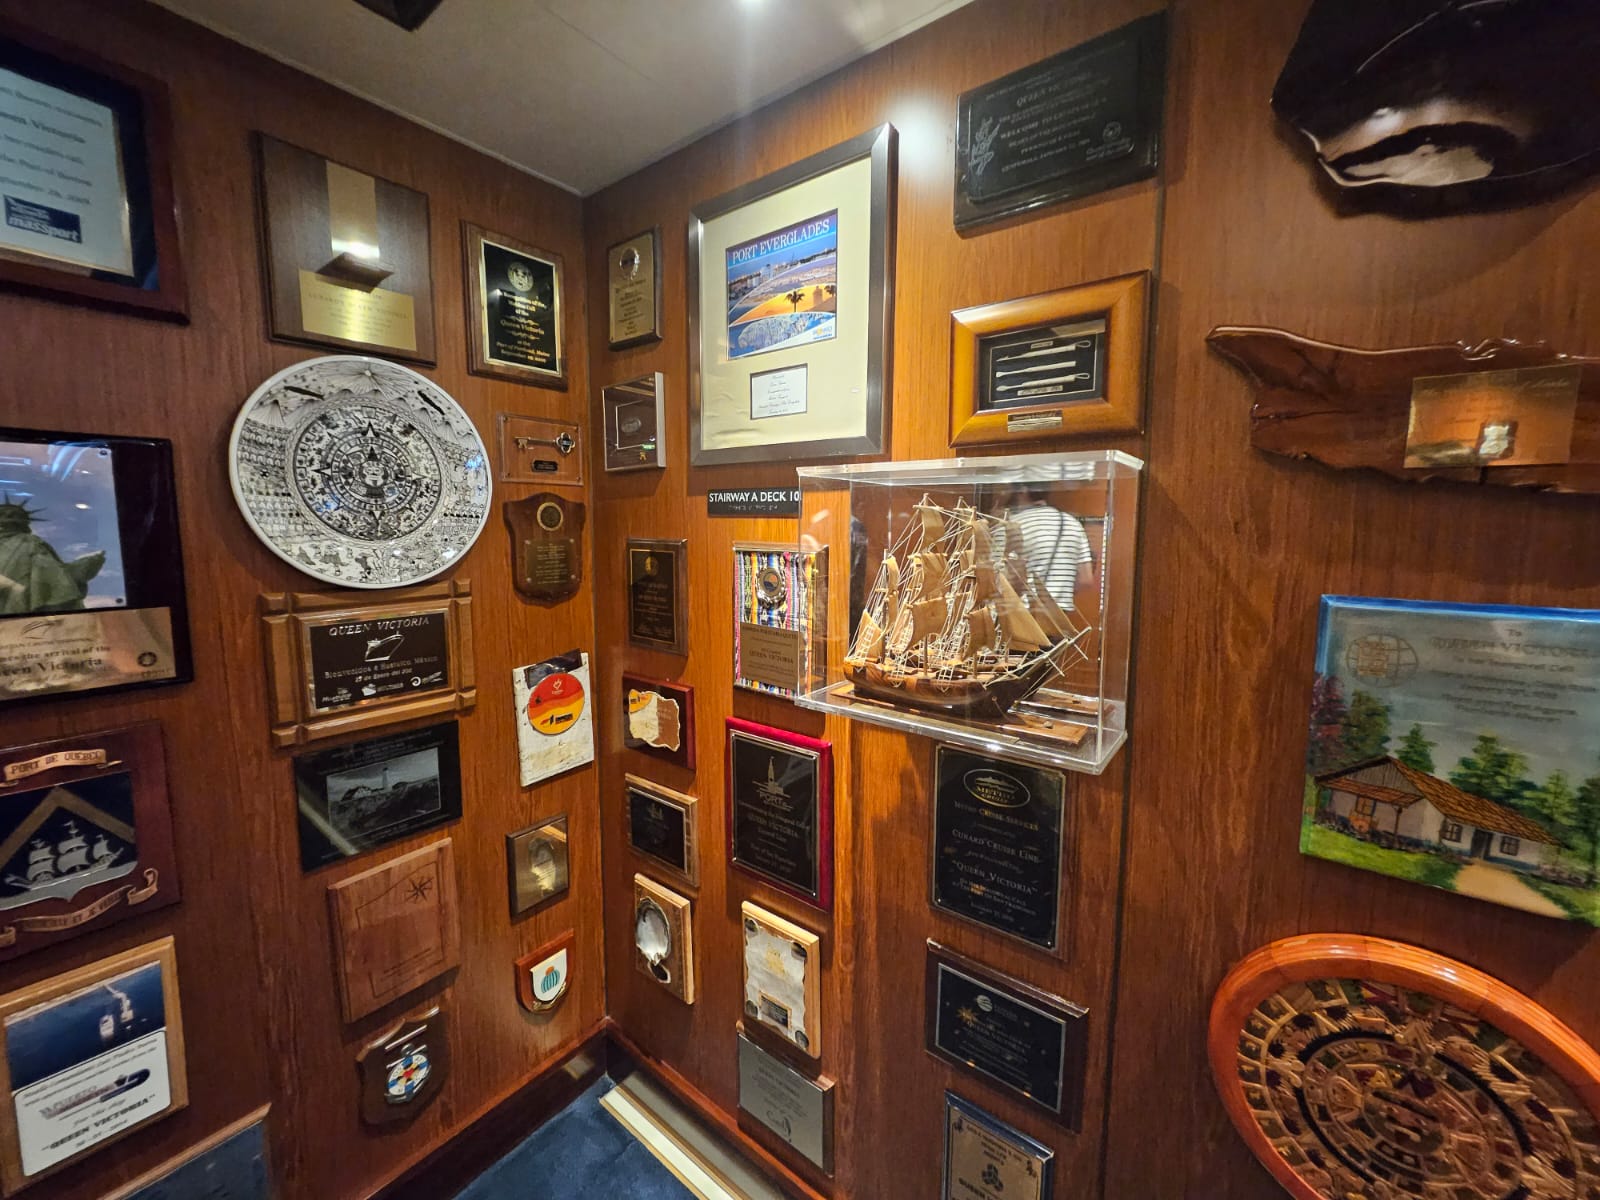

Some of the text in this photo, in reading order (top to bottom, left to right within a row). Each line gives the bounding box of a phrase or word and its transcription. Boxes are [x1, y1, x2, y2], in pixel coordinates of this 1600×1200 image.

[8, 215, 81, 241] massport
[732, 218, 830, 265] PORT EVERGLADES
[708, 489, 800, 503] STAIRWAY A DECK 10
[328, 617, 430, 637] QUEEN VICTORIA
[44, 647, 80, 658] arrival
[82, 646, 94, 655] of
[37, 657, 103, 676] Victoria
[11, 760, 40, 774] PORT
[45, 754, 58, 765] DE
[951, 827, 985, 846] CUNARD
[986, 838, 1016, 856] CRUISE
[1018, 848, 1040, 864] LINE
[50, 1125, 91, 1149] QUEEN
[93, 1097, 150, 1128] VICTORIA
